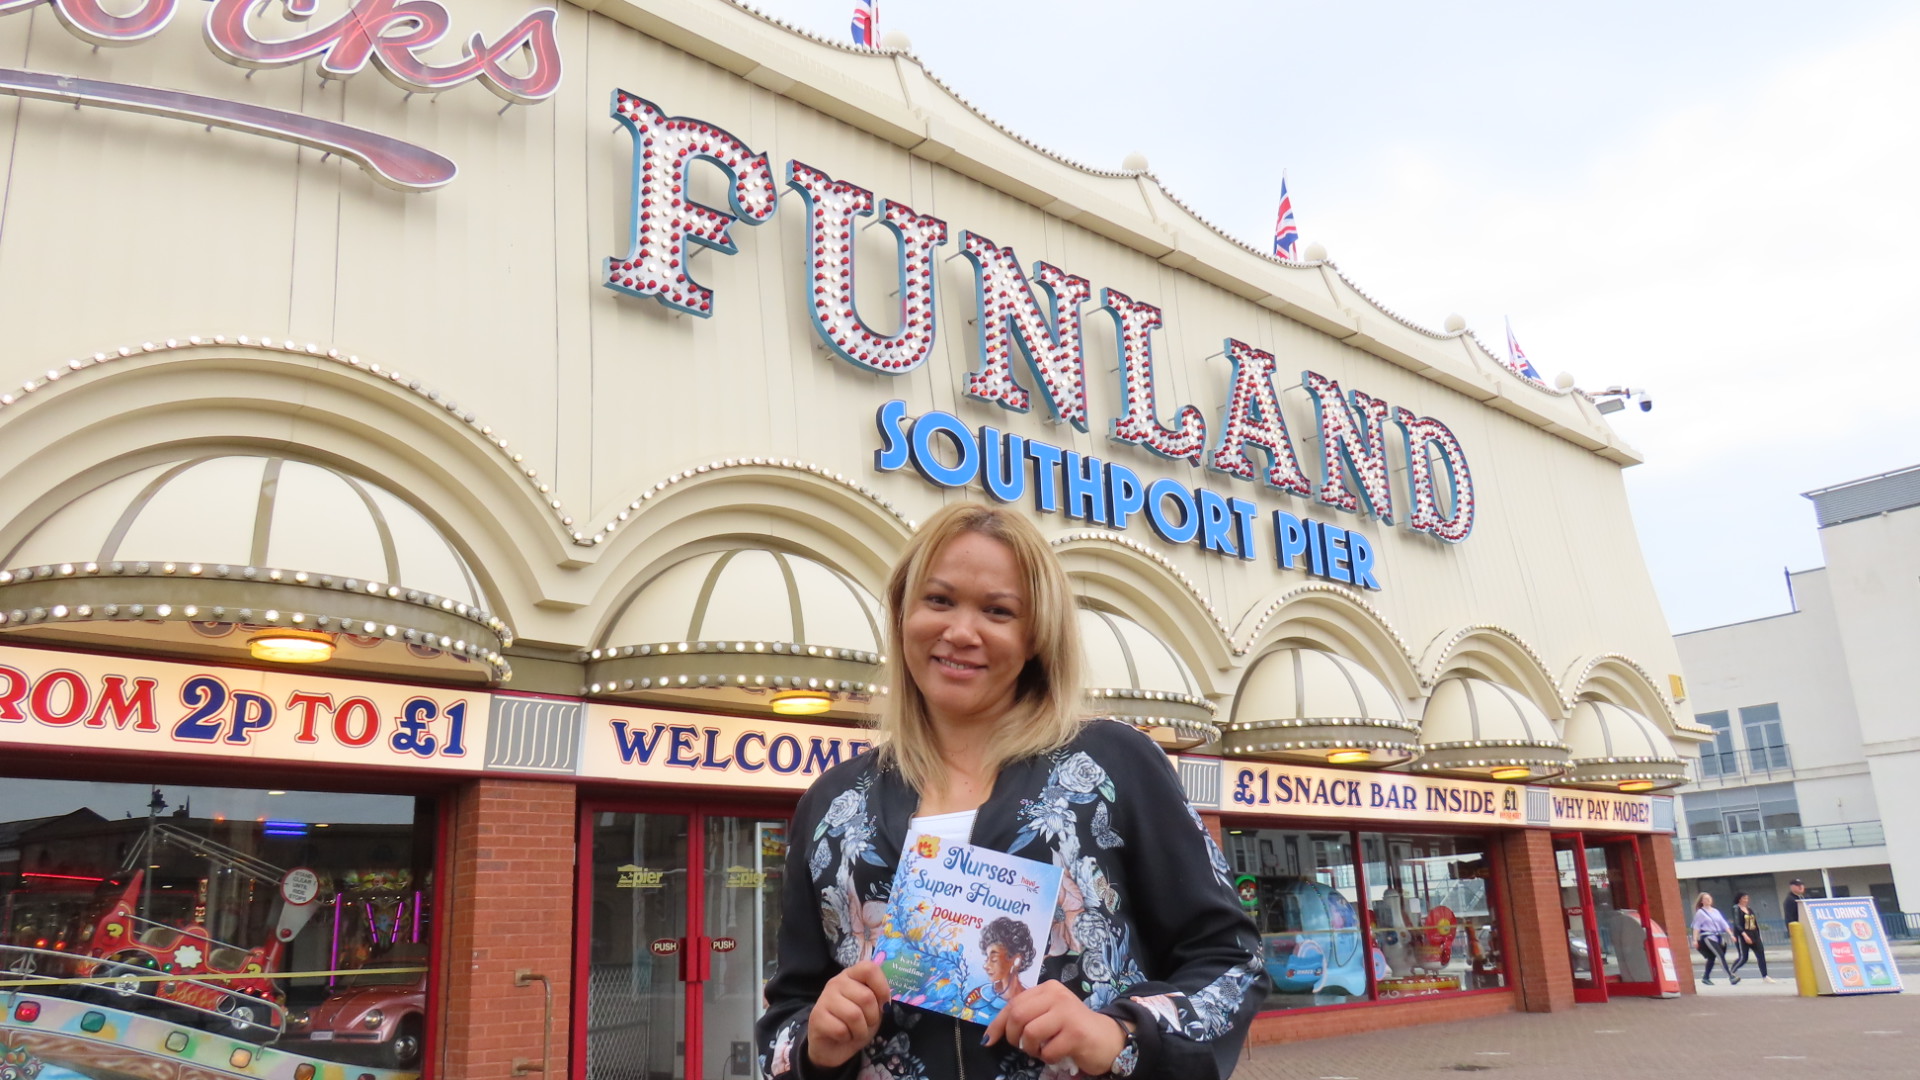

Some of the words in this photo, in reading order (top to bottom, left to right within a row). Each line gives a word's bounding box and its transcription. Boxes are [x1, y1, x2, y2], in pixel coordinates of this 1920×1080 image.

[602, 87, 1474, 544] FUNLAND
[874, 400, 1257, 561] SOUTHPORT
[1273, 510, 1381, 591] PIER
[286, 689, 381, 747] TO
[388, 695, 468, 759] £1
[1232, 767, 1270, 807] £1
[1274, 774, 1363, 808] SNACK
[1370, 782, 1417, 811] BAR
[1425, 787, 1496, 815] INSIDE
[1552, 797, 1584, 820] WHY
[1587, 800, 1610, 821] PAY
[1612, 802, 1649, 823] MORE?
[633, 868, 664, 887] pier
[740, 868, 767, 887] pier
[943, 846, 1017, 885] Nurses
[913, 869, 962, 897] Super
[966, 882, 1031, 916] Flower
[931, 906, 984, 929] powers
[1815, 908, 1835, 920] ALL
[1833, 906, 1868, 919] DRINKS
[653, 942, 677, 952] PUSH
[713, 939, 735, 950] PUSH
